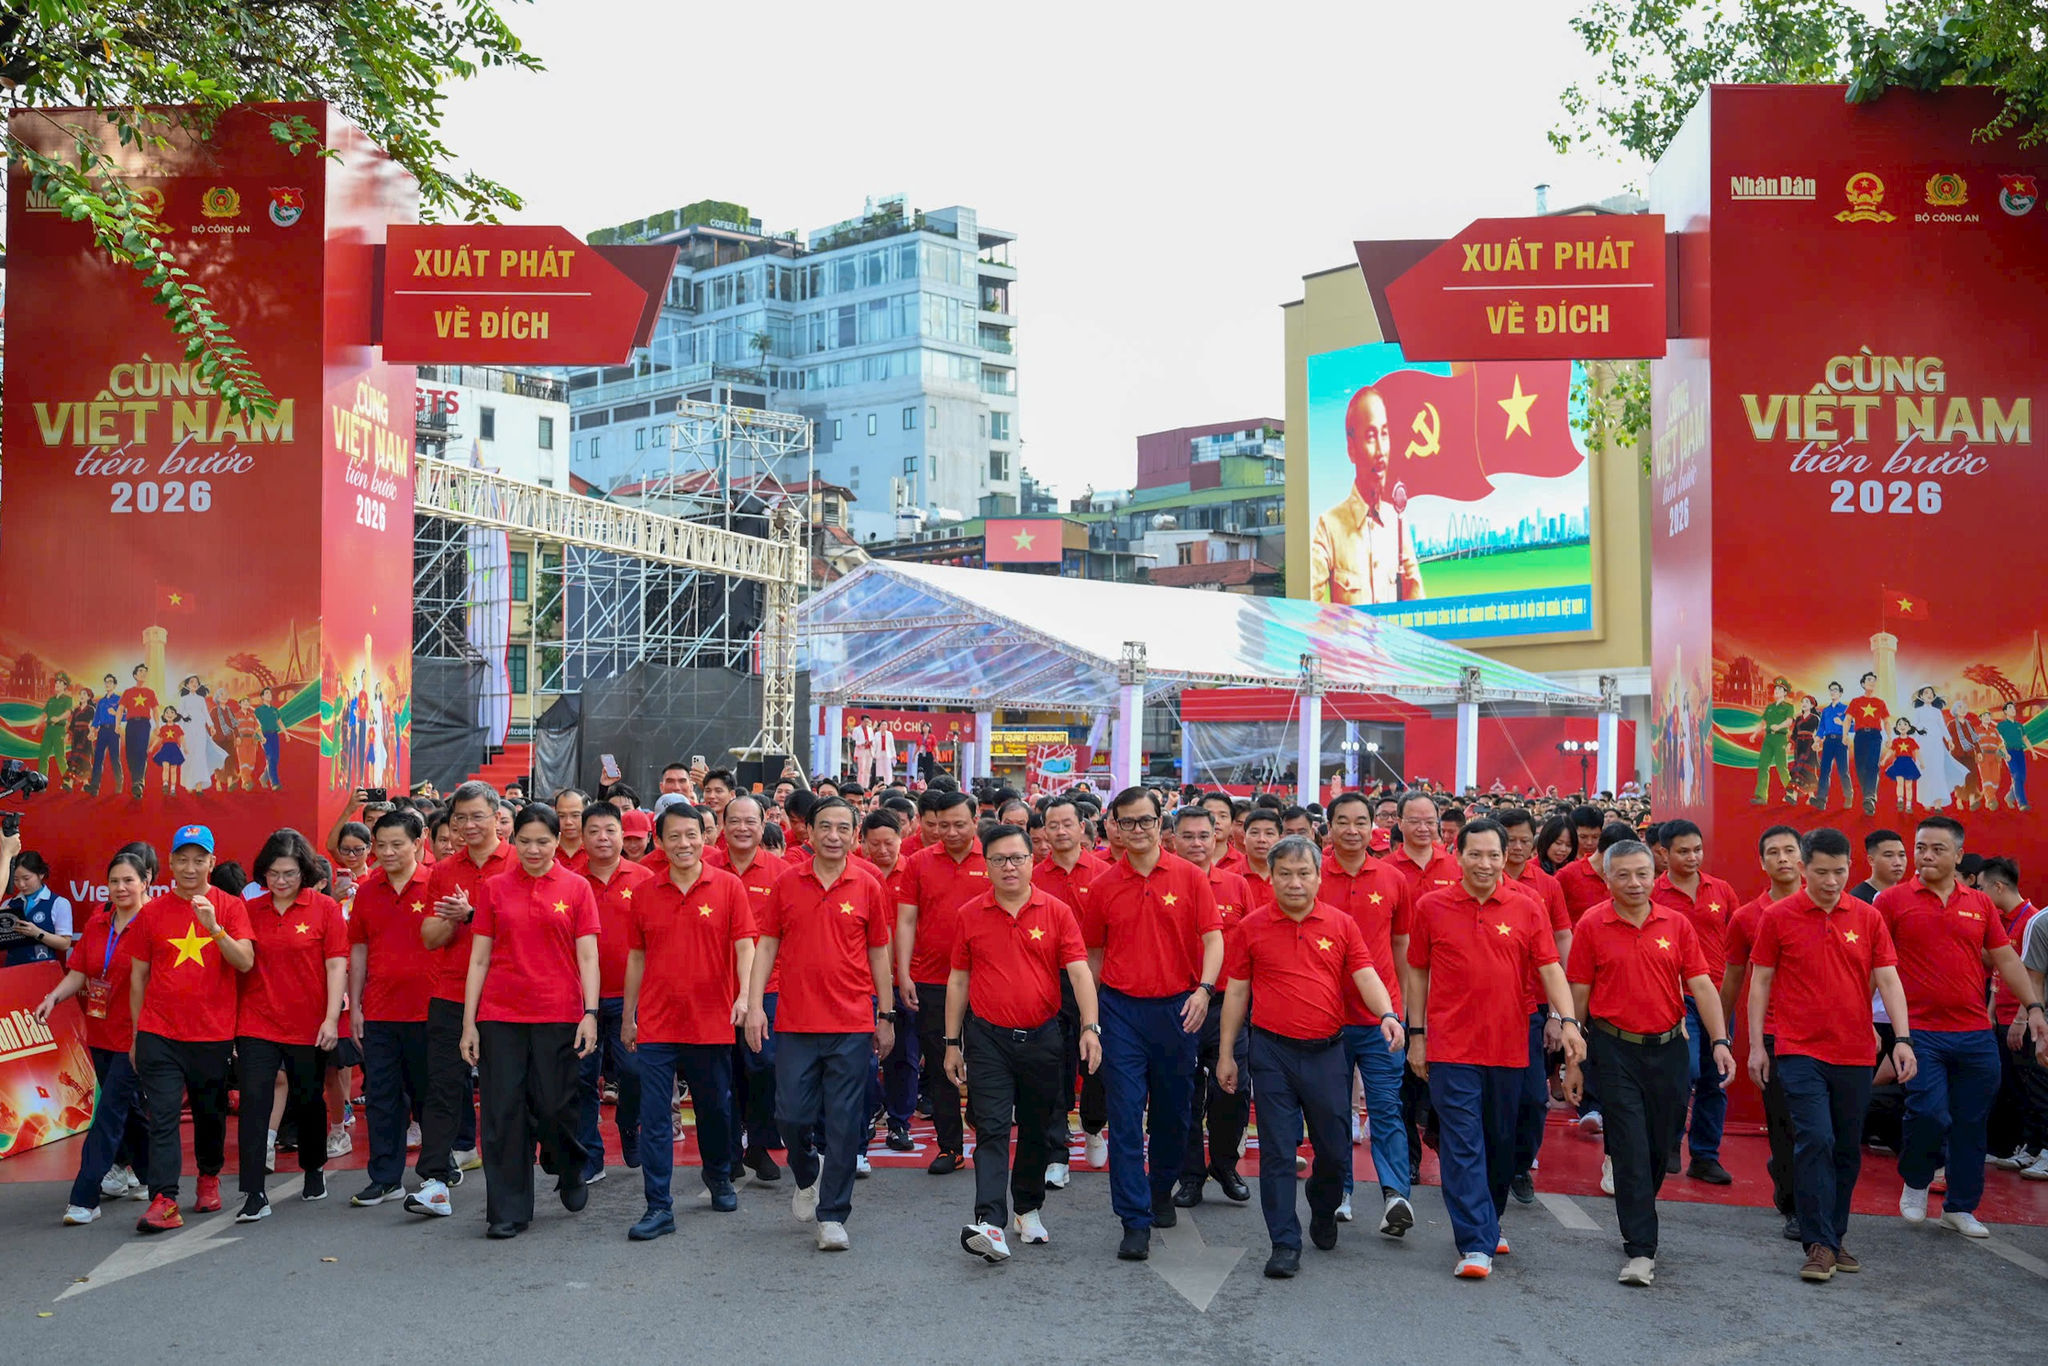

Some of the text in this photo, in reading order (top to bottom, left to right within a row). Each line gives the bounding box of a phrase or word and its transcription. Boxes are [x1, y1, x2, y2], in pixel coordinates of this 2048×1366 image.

[1731, 176, 1816, 196] Nhân Dân
[192, 224, 251, 235] BỘ CÔNG AN
[1915, 212, 1980, 223] BỘ CÔNG AN
[412, 243, 575, 278] XUẤT PHÁT
[1461, 235, 1635, 272] XUẤT PHÁT
[434, 304, 549, 339] VỀ ĐÍCH
[1486, 299, 1609, 335] VỀ ĐÍCH
[109, 352, 217, 398] CÙNG
[1825, 345, 1946, 393] CÙNG
[357, 376, 389, 425] CÙNG
[1740, 382, 2032, 450] VIỆT NAM
[33, 391, 295, 455] VIỆT NAM
[332, 404, 408, 478] VIỆT NAM
[75, 432, 256, 477] tiến bước
[1789, 431, 1989, 476] tiến bước
[110, 480, 212, 514] 2026
[345, 455, 398, 501] tiến bước
[1830, 480, 1942, 515] 2026
[356, 493, 387, 532] 2026
[1669, 496, 1690, 538] 2026
